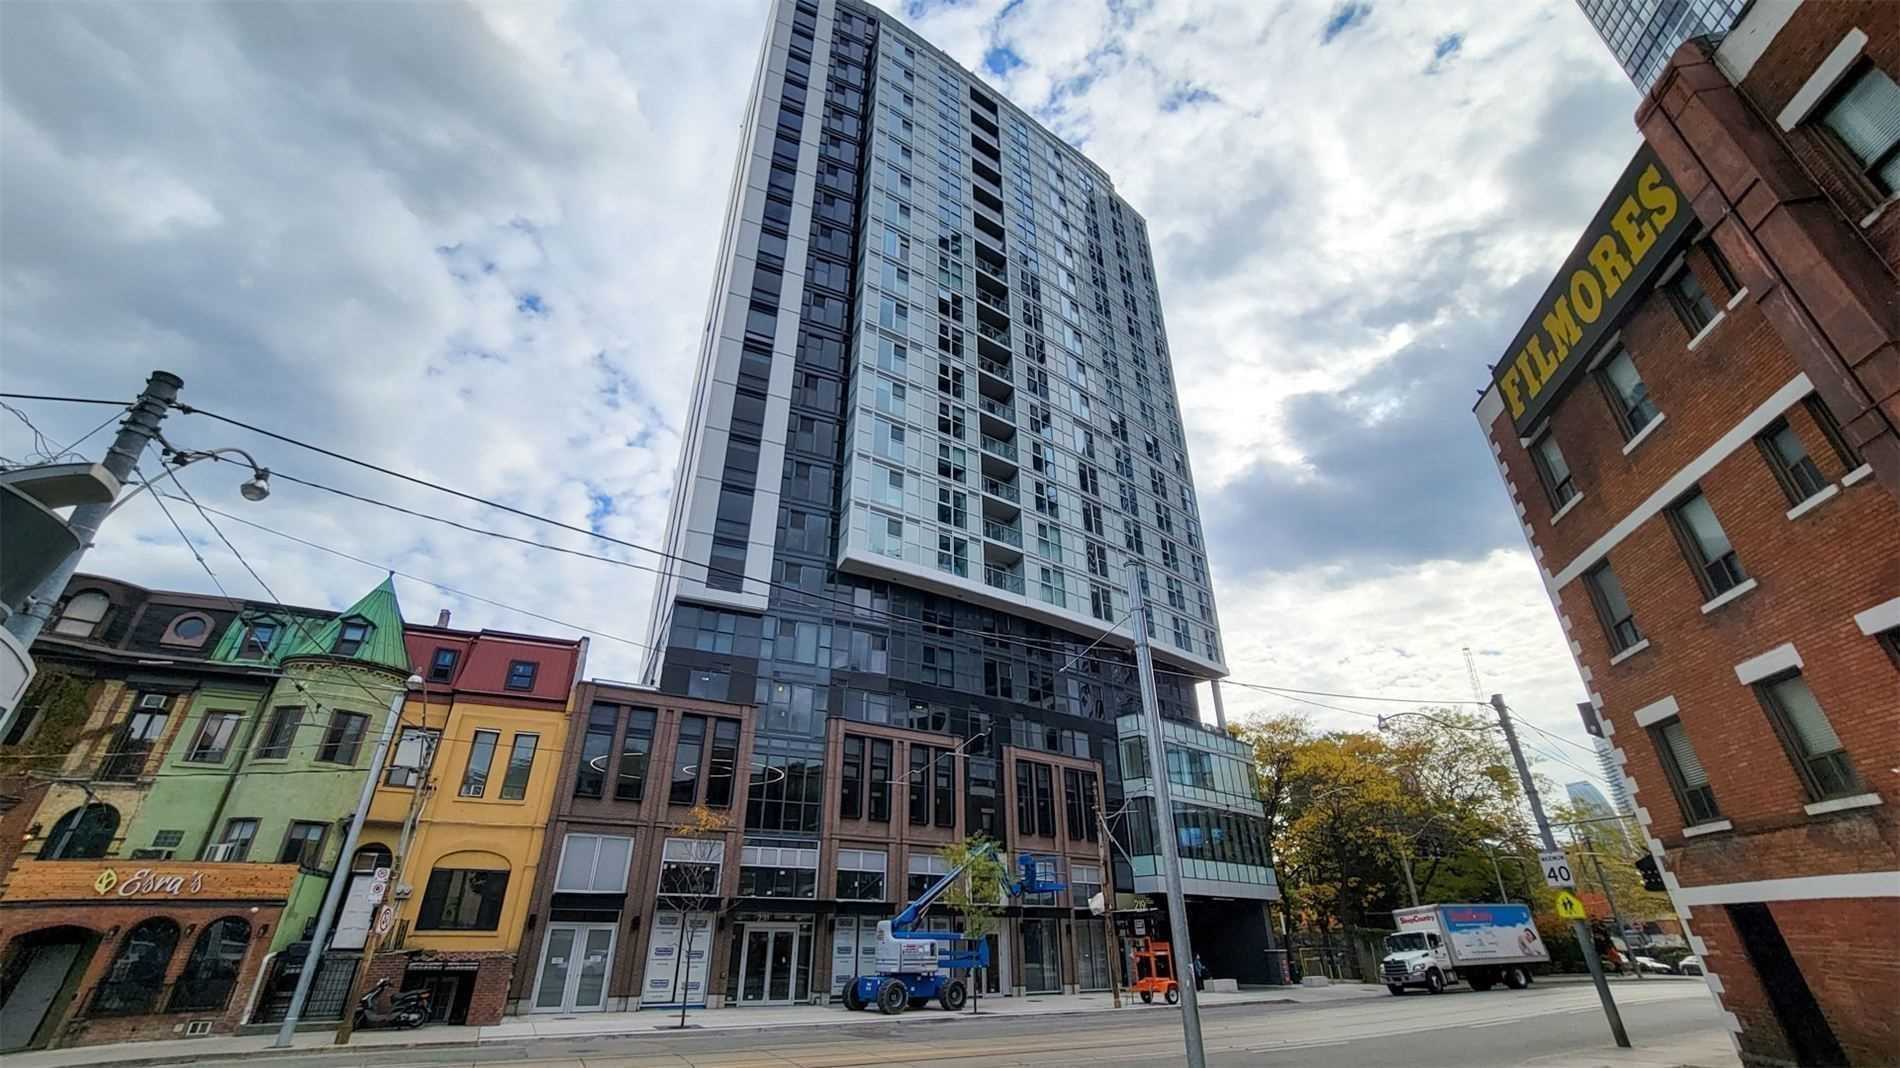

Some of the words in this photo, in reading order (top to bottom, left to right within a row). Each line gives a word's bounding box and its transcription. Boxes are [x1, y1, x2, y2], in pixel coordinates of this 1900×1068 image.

[1499, 163, 1678, 420] FILMORES
[118, 868, 205, 896] Esra's
[1547, 865, 1571, 882] 40
